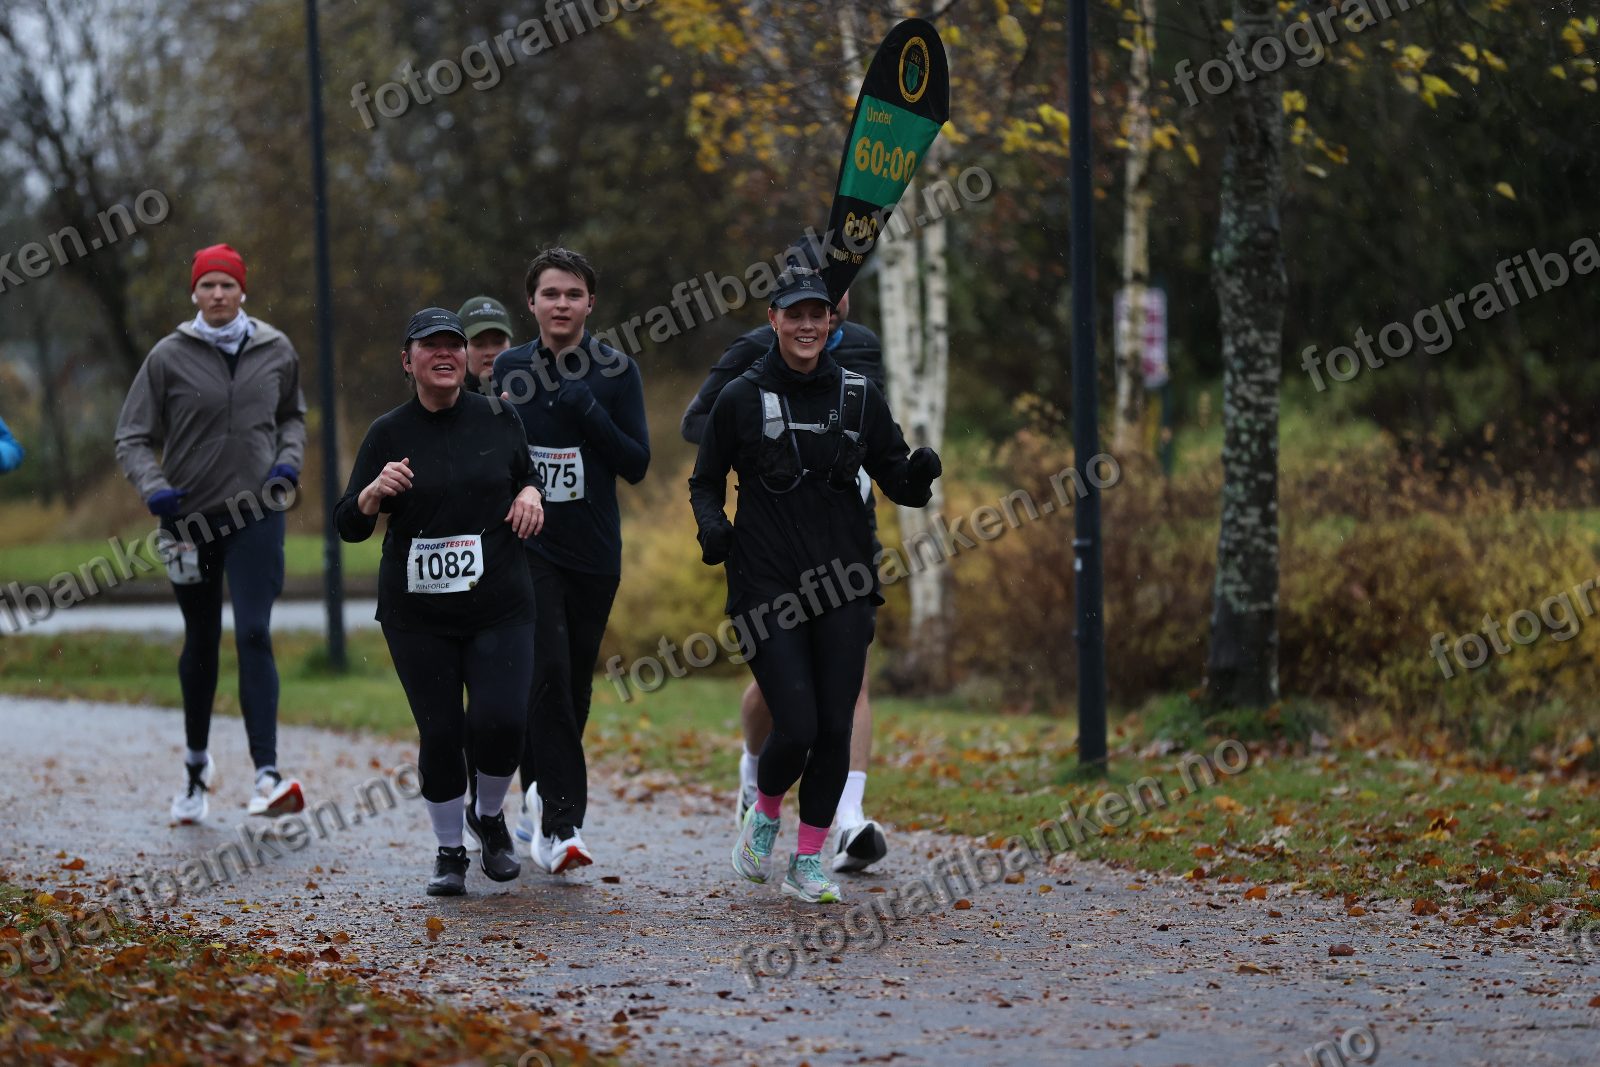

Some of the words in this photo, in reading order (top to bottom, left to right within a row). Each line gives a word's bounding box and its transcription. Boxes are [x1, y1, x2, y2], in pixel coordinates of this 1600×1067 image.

[867, 106, 892, 125] Under
[854, 136, 917, 184] 60:00
[844, 211, 877, 242] 6:00
[537, 461, 577, 489] 075
[415, 550, 476, 580] 1082
